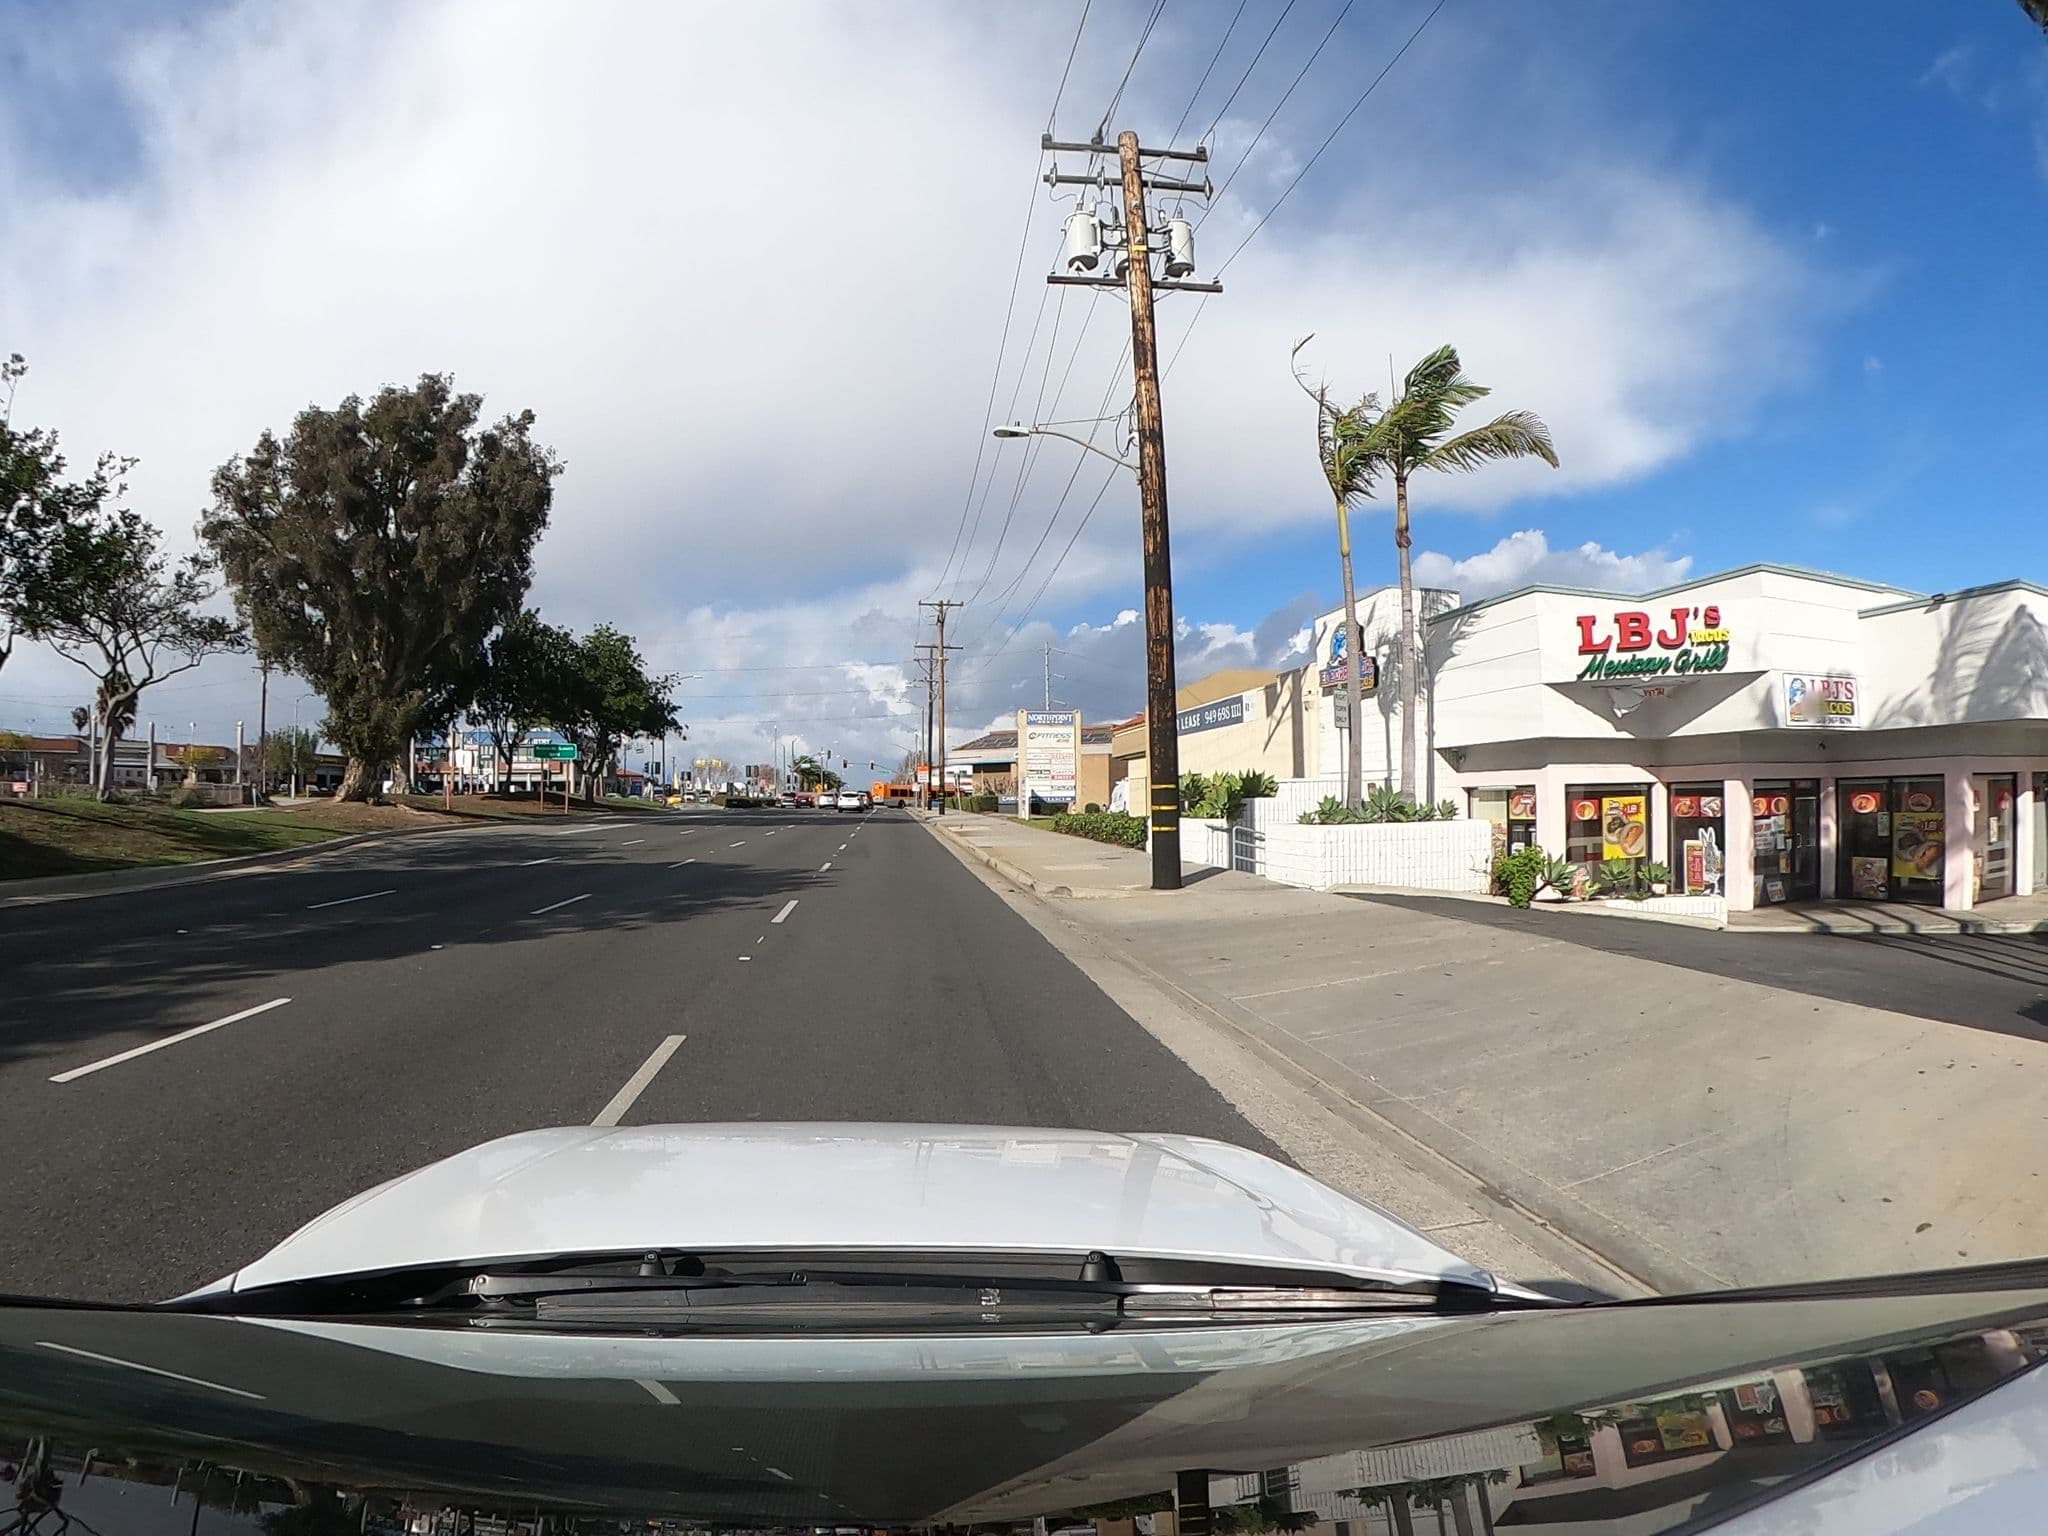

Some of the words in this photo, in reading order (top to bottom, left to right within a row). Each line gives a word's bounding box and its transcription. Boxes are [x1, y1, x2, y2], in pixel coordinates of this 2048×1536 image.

[1576, 654, 1672, 680] Mexican
[1673, 645, 1730, 675] Grill
[1028, 713, 1073, 722] NORTHPOINT
[1181, 713, 1201, 730] LEASE
[1205, 709, 1217, 724] 949
